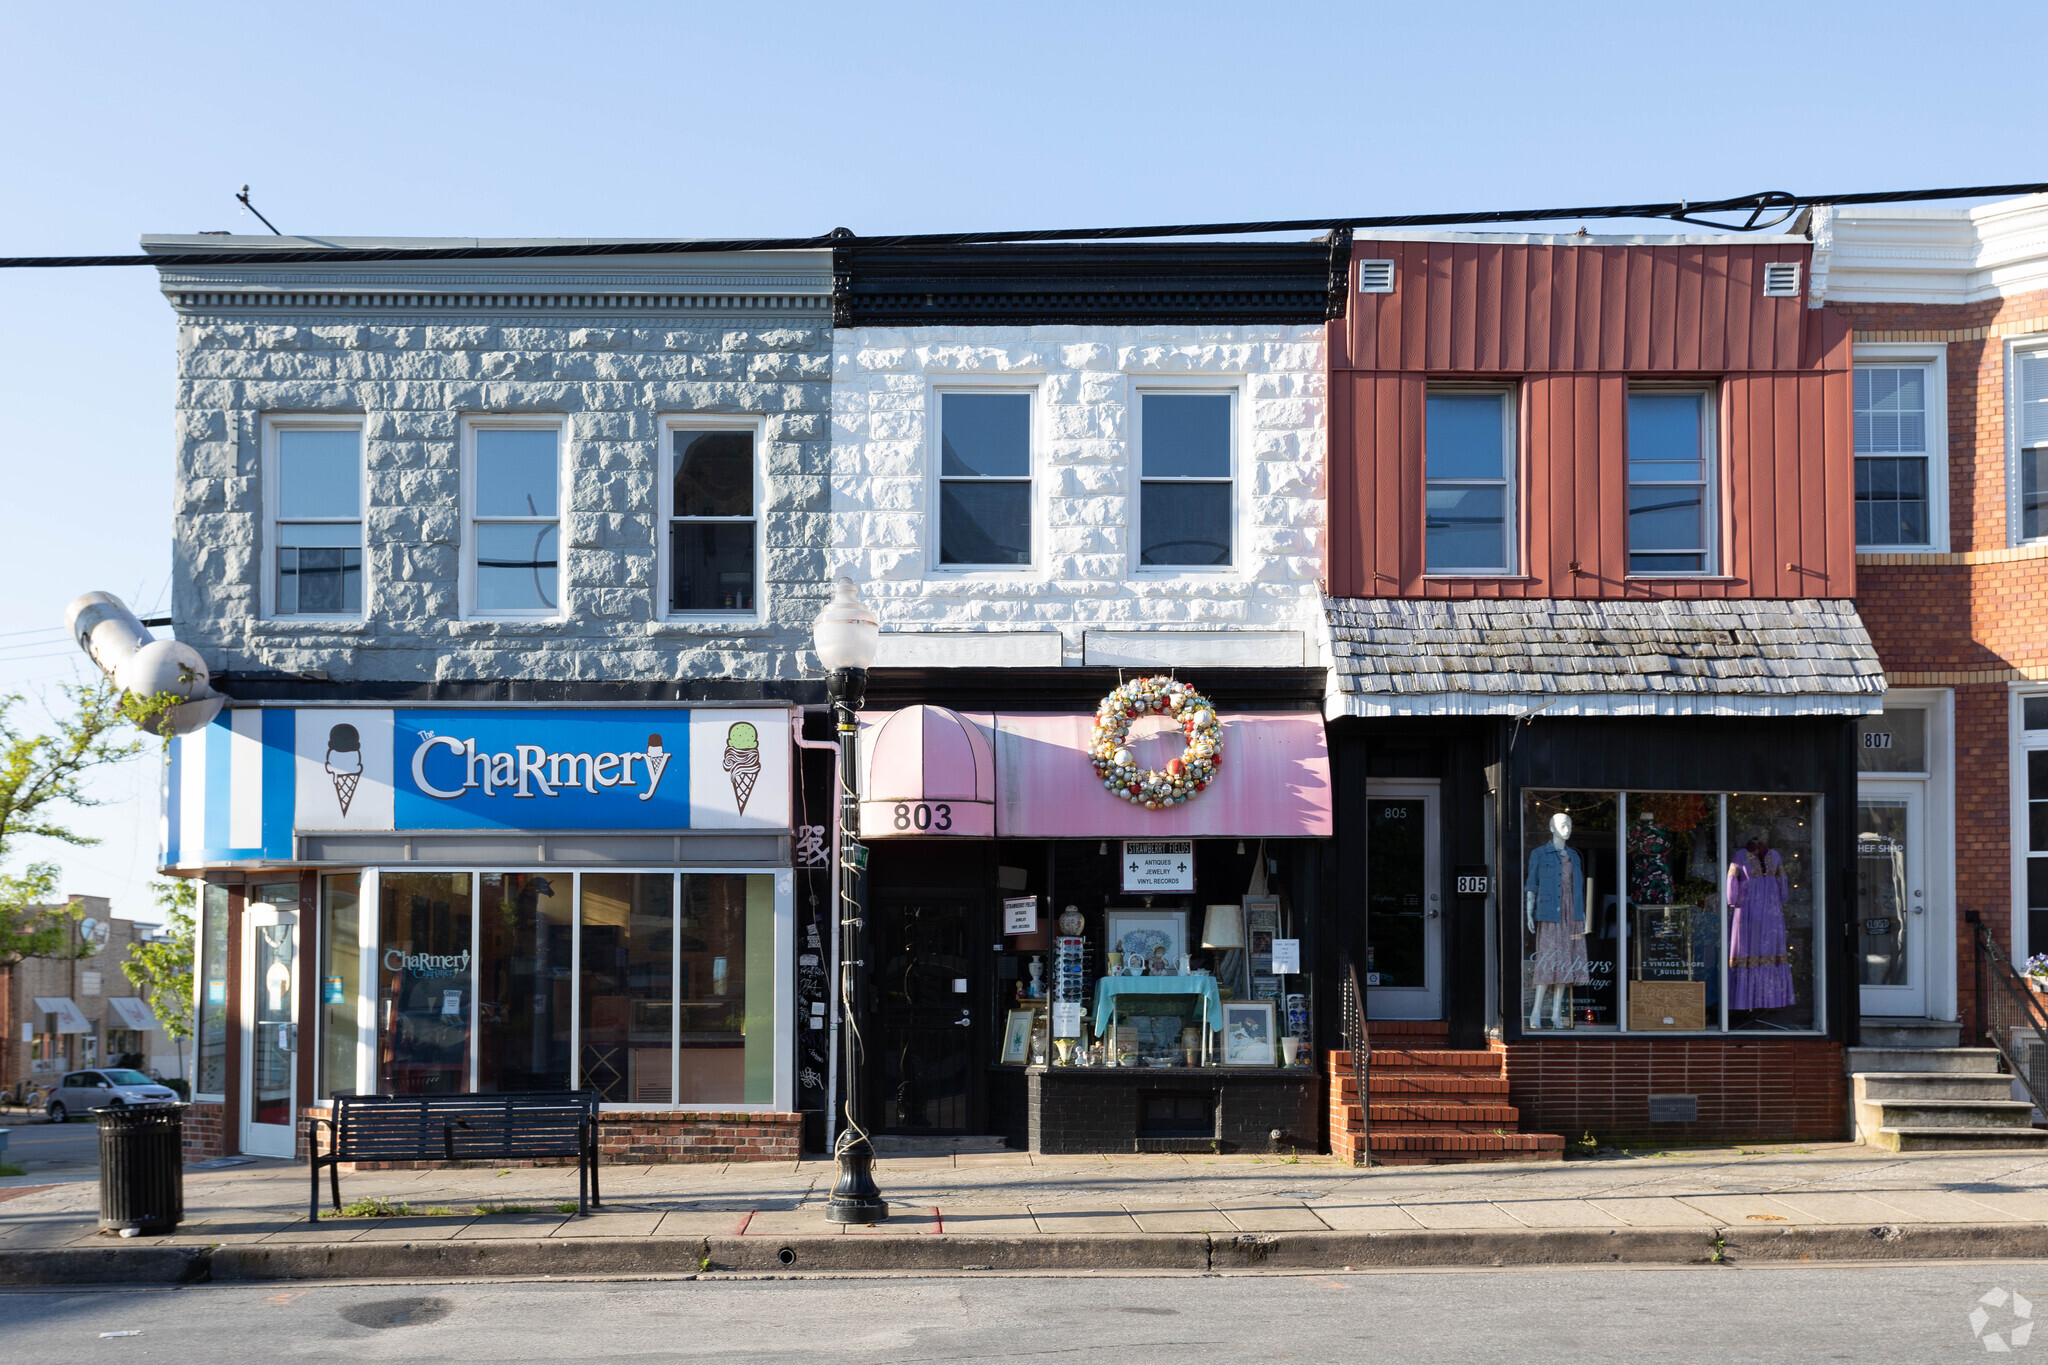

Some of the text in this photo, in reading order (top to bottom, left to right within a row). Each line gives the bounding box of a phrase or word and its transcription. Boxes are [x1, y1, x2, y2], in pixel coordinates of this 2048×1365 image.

[418, 730, 435, 742] The
[1864, 733, 1891, 748] 807
[893, 803, 952, 831] 803
[1384, 808, 1407, 819] 805
[1128, 842, 1190, 854] STRAWBERRY FIELDS
[1858, 844, 1904, 853] HEF SHOP
[1459, 877, 1486, 892] 805
[1528, 949, 1615, 982] Keepers
[1640, 984, 1696, 1004] Keepers
[1640, 1002, 1696, 1024] Vintage
